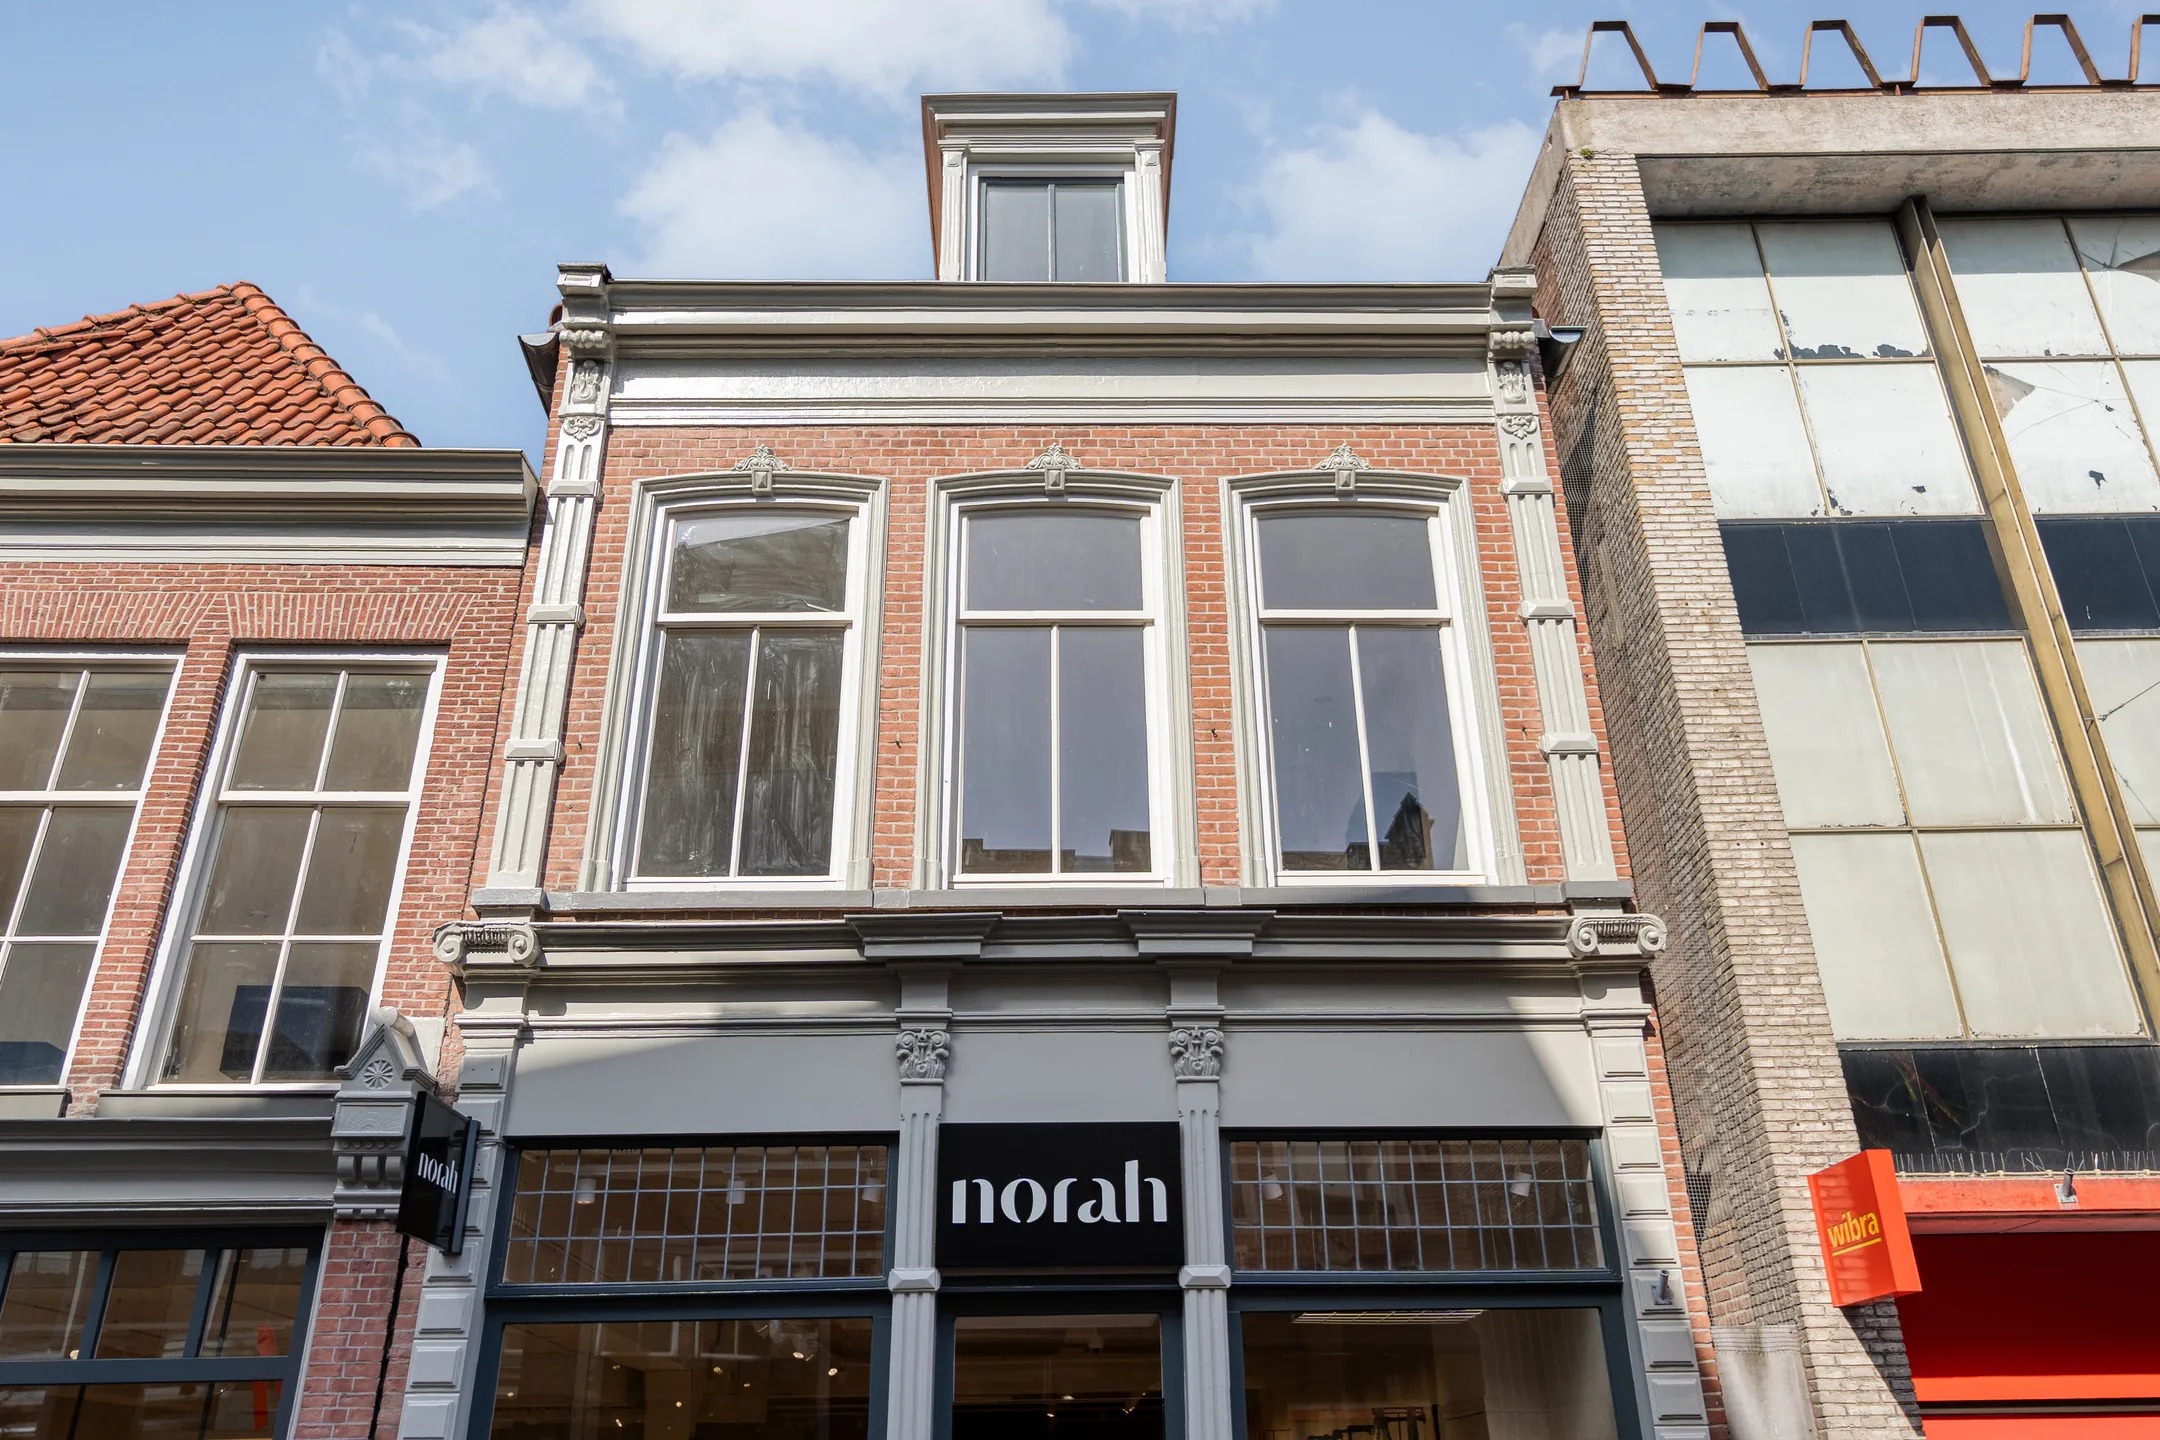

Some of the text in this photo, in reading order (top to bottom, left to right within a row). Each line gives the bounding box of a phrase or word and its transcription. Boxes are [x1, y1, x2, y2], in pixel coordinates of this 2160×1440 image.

[417, 1152, 458, 1194] norah
[952, 1159, 1168, 1224] norah
[1827, 1211, 1880, 1248] wibra
